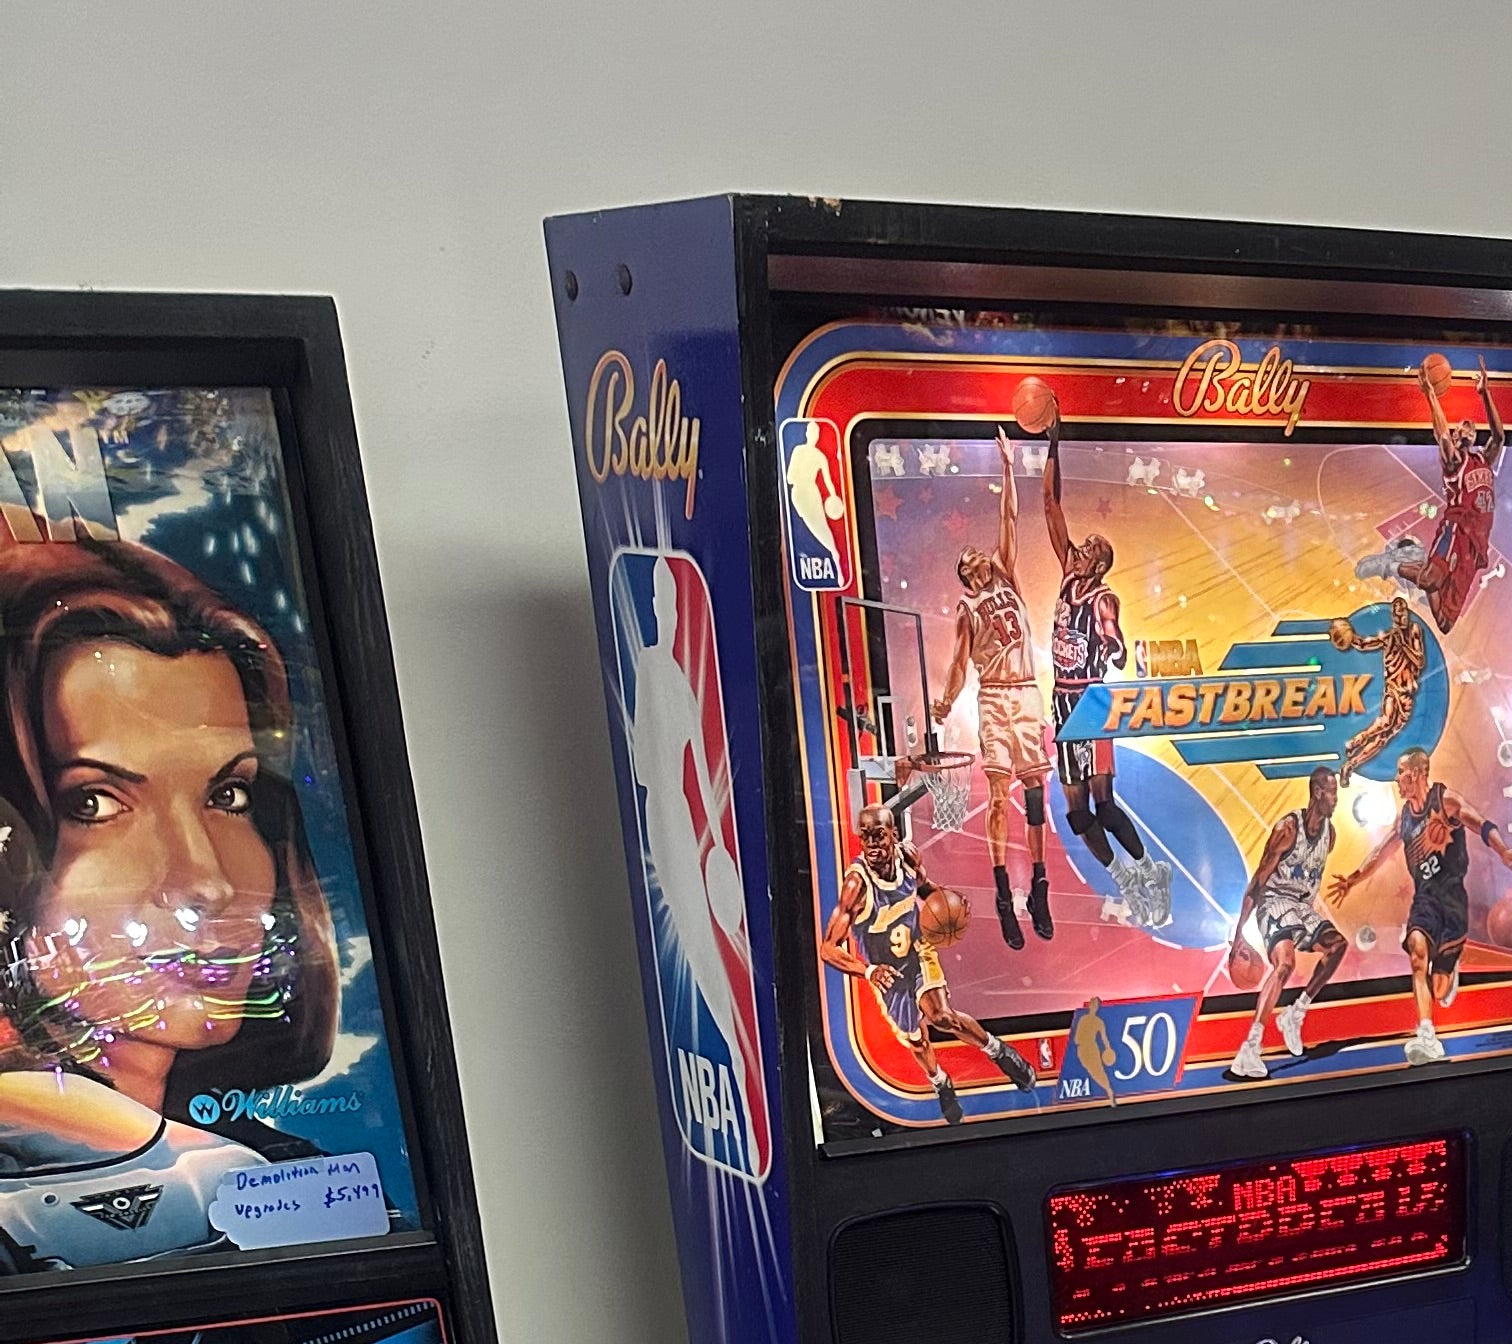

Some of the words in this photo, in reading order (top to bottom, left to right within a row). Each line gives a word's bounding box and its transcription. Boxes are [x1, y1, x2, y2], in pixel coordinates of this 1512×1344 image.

[1173, 338, 1311, 435] Bally
[585, 349, 703, 519] Bally
[800, 555, 835, 581] NBA
[1150, 639, 1203, 677] NBA
[1102, 671, 1367, 732] FASTBREAK
[1418, 855, 1441, 881] 32
[890, 923, 912, 958] 9
[1114, 1011, 1176, 1080] 50
[222, 1084, 362, 1122] Williams
[678, 1047, 741, 1141] NBA
[1059, 1077, 1091, 1099] NBA
[236, 1166, 319, 1191] Demolition
[323, 1184, 380, 1208] $5,499
[1232, 1175, 1297, 1212] NBA
